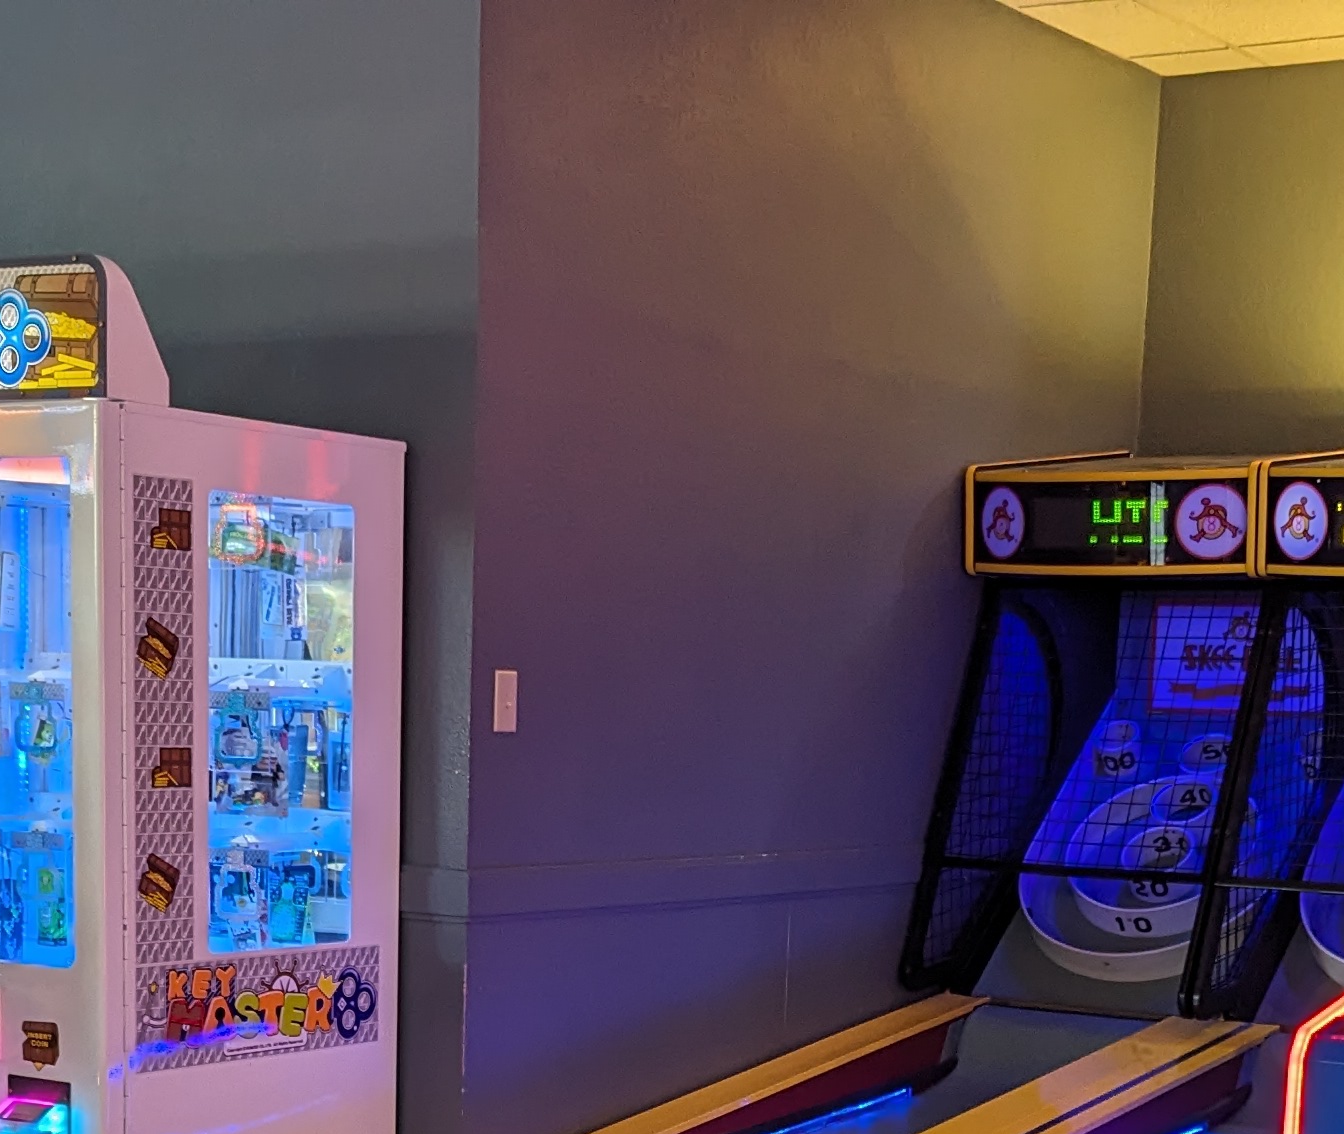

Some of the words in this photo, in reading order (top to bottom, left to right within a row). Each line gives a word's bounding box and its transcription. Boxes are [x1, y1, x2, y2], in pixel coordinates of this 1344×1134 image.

[1115, 916, 1153, 932] 10
[167, 965, 237, 1001] KEY
[166, 986, 333, 1047] MASTER
